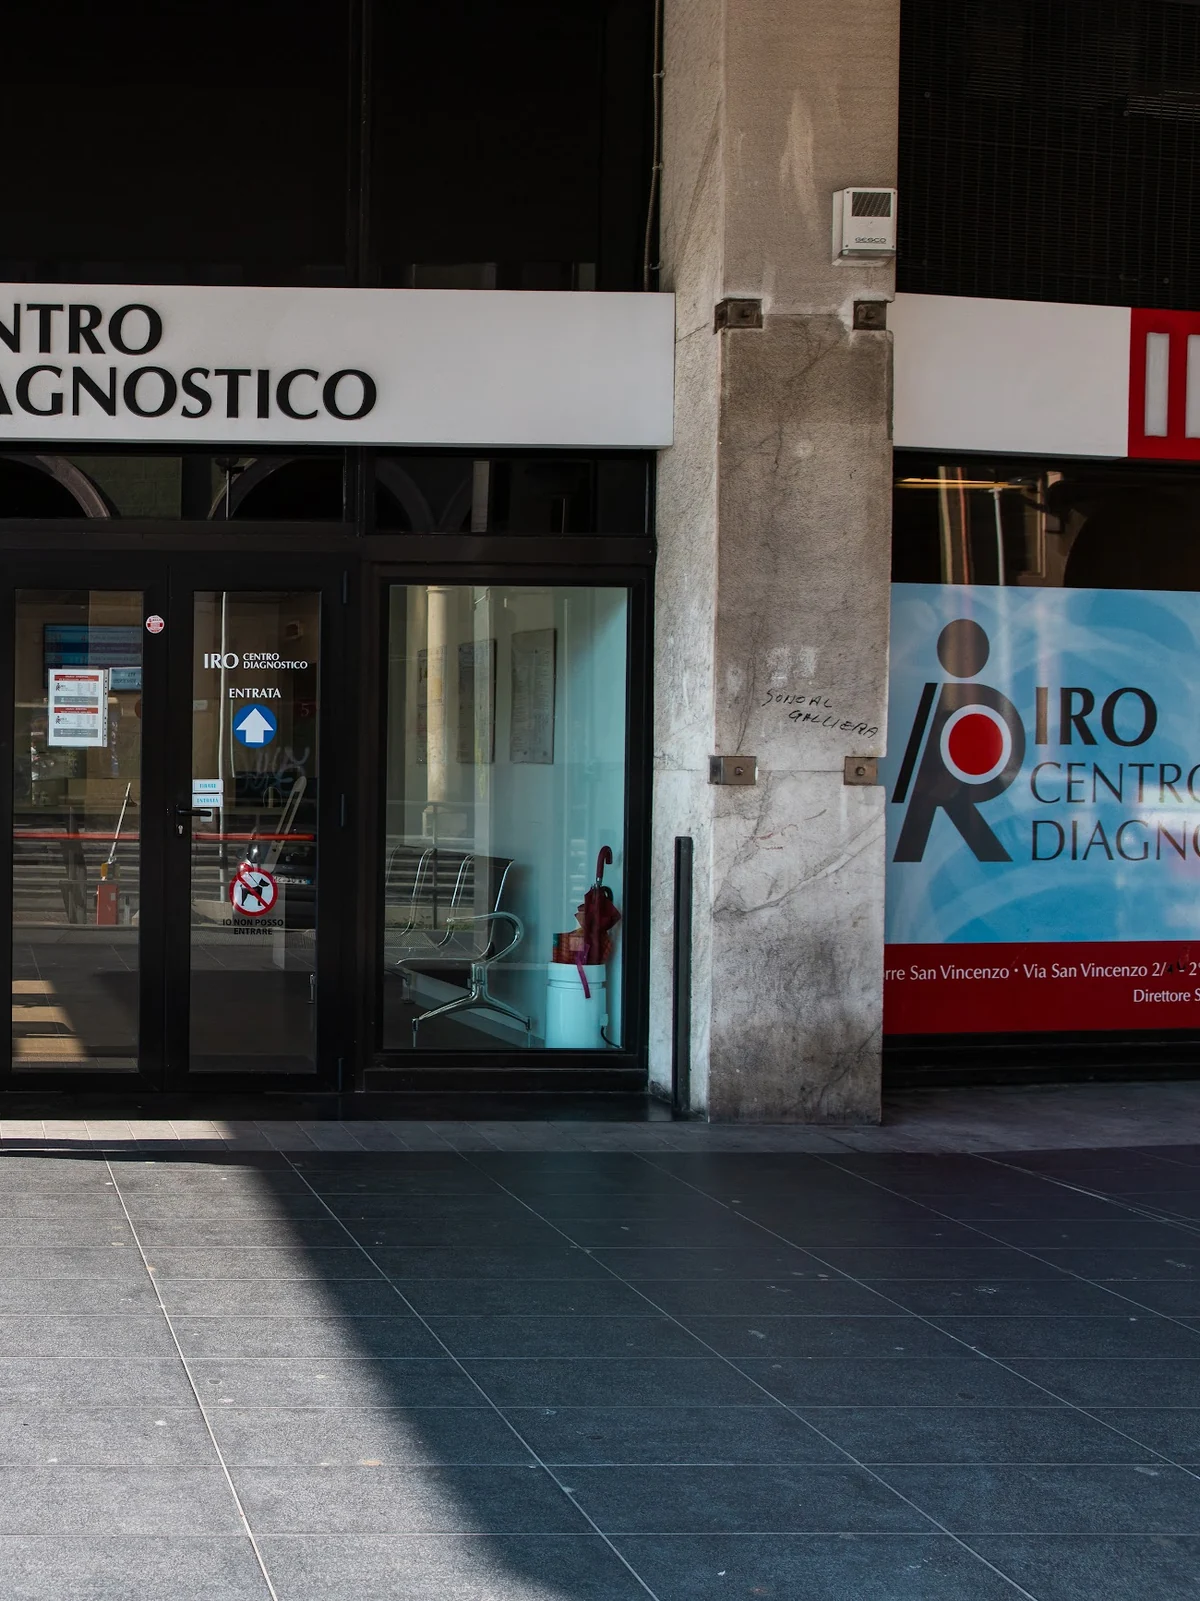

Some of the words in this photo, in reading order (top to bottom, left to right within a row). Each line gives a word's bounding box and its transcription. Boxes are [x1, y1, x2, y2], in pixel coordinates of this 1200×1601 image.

[204, 653, 239, 669] IRO
[243, 652, 280, 661] CENTRO
[243, 661, 308, 669] DIAGNOSTICO
[229, 688, 282, 698] ENTRATA
[1035, 686, 1158, 747] IRO
[1031, 820, 1200, 861] DIAGN
[255, 919, 284, 927] POSSO
[233, 927, 273, 935] ENTRARE
[884, 968, 906, 980] rre
[910, 965, 937, 980] San
[940, 964, 1010, 979] Vincenzo
[1023, 963, 1047, 978] Via
[1051, 963, 1077, 978] San
[1080, 962, 1148, 977] Vincenzo
[1133, 988, 1191, 1003] Direttore
